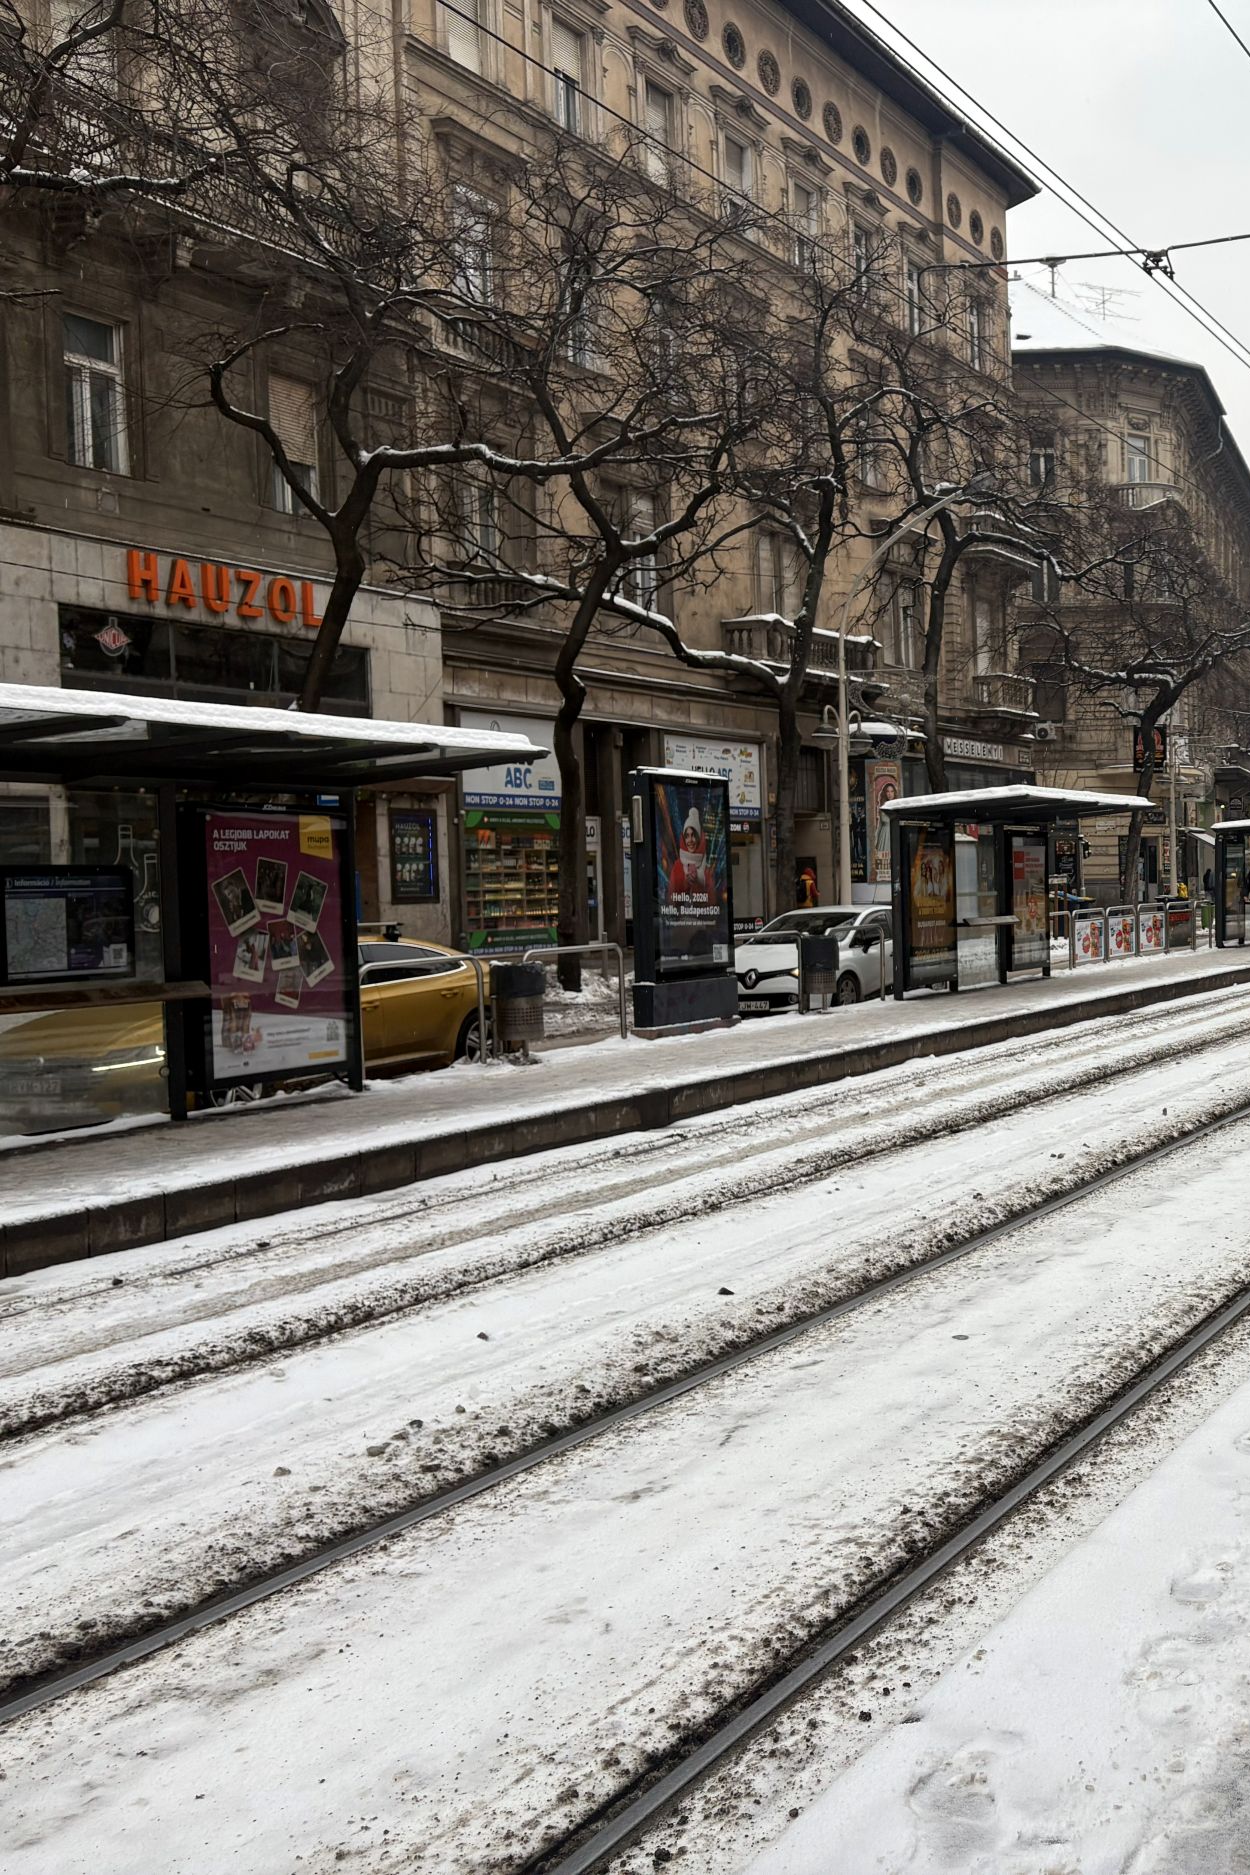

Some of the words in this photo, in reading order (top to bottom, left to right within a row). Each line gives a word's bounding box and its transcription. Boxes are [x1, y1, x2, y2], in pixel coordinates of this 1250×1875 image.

[126, 550, 322, 627] HAUZOL
[504, 767, 533, 789] ABC
[465, 795, 480, 803] NON
[481, 795, 497, 805] STOP
[514, 798, 528, 806] NON
[529, 798, 544, 806] STOP
[253, 830, 290, 840] LAPOKAT
[672, 892, 692, 903] Hello,
[692, 893, 709, 903] 2026!
[661, 905, 680, 916] Hello,
[680, 905, 720, 918] BudapestGO!
